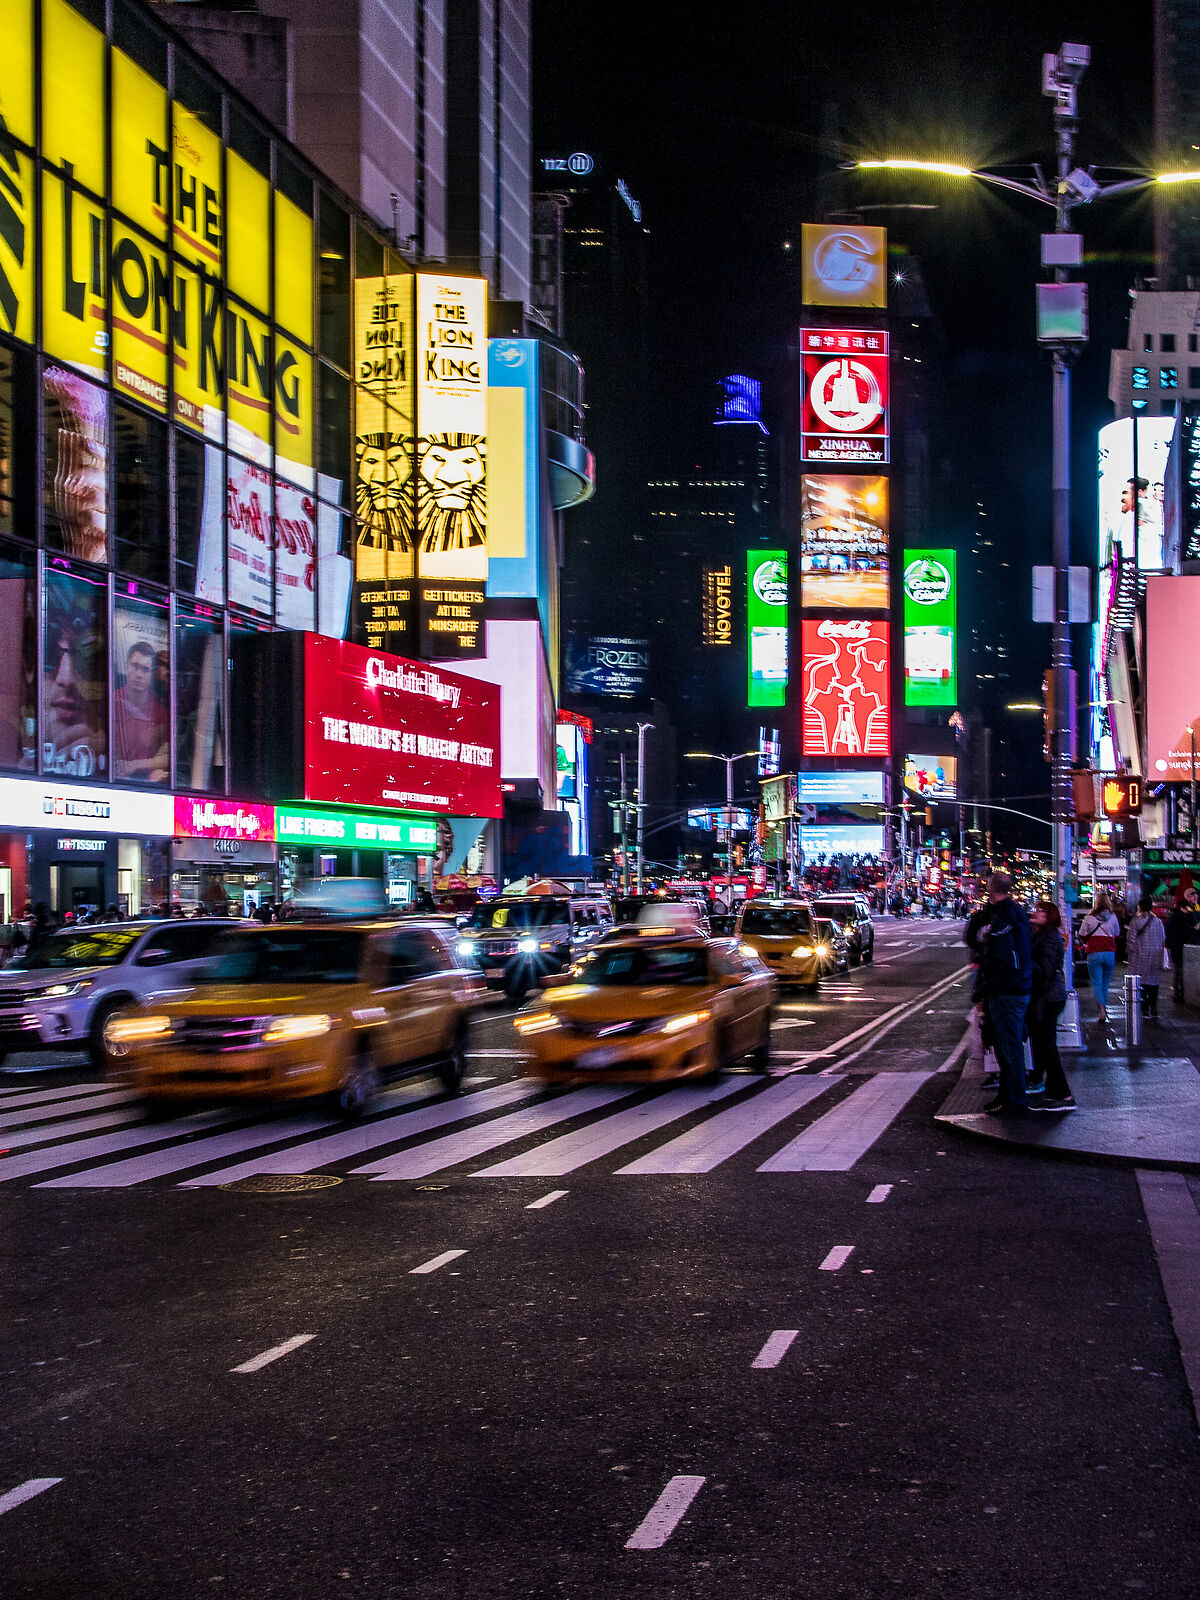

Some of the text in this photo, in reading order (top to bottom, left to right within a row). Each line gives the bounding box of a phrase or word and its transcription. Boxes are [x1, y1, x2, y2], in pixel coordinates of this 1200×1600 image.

[146, 139, 221, 246] THE
[60, 157, 300, 420] LION KING
[433, 303, 466, 320] THE
[427, 321, 473, 348] LION
[424, 350, 481, 381] KING
[116, 365, 168, 403] ENTRANCE
[819, 439, 871, 450] XINHUA
[714, 565, 732, 645] NOVOTEL
[587, 647, 649, 668] FROZEN
[322, 717, 350, 743] THE
[65, 798, 110, 818] TISSOT
[72, 839, 107, 851] TISSOT
[1163, 850, 1194, 862] NYC
